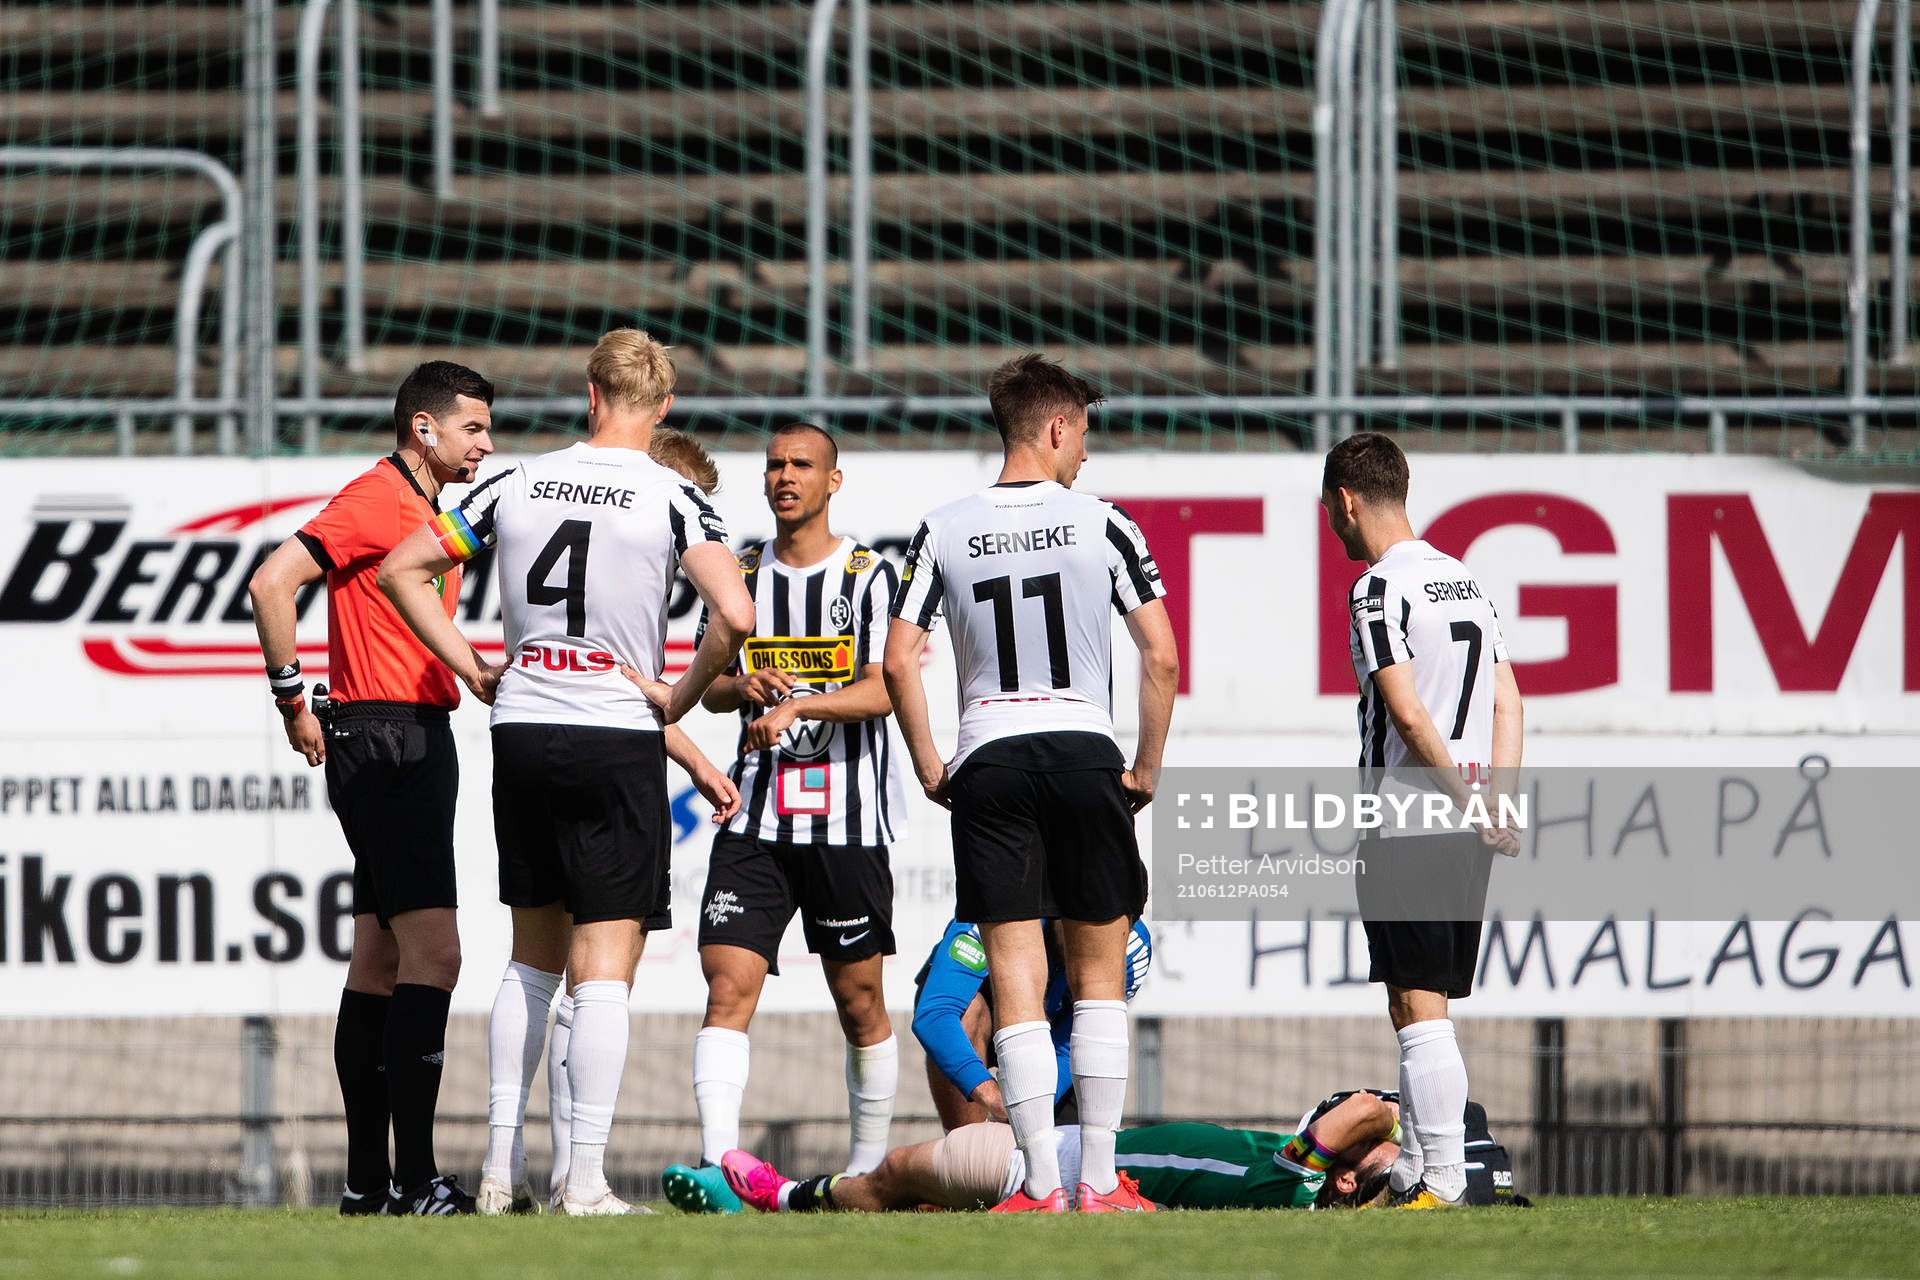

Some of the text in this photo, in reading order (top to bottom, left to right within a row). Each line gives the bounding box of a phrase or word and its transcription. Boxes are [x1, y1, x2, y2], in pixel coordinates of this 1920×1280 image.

[530, 481, 636, 509] SERNEKE
[968, 524, 1077, 559] SERNEKE
[527, 519, 592, 638] 4
[1424, 579, 1482, 604] SERNEK
[521, 645, 616, 672] PULS
[752, 650, 834, 669] OHLSSONS
[972, 571, 1071, 692] 11
[1450, 620, 1482, 741] 7
[97, 775, 179, 813] ALLA
[191, 775, 312, 813] DAGAR
[1245, 754, 1832, 860] LUHA PÅ
[0, 853, 356, 965] ken.se
[1248, 908, 1912, 991] HIMALAGA
